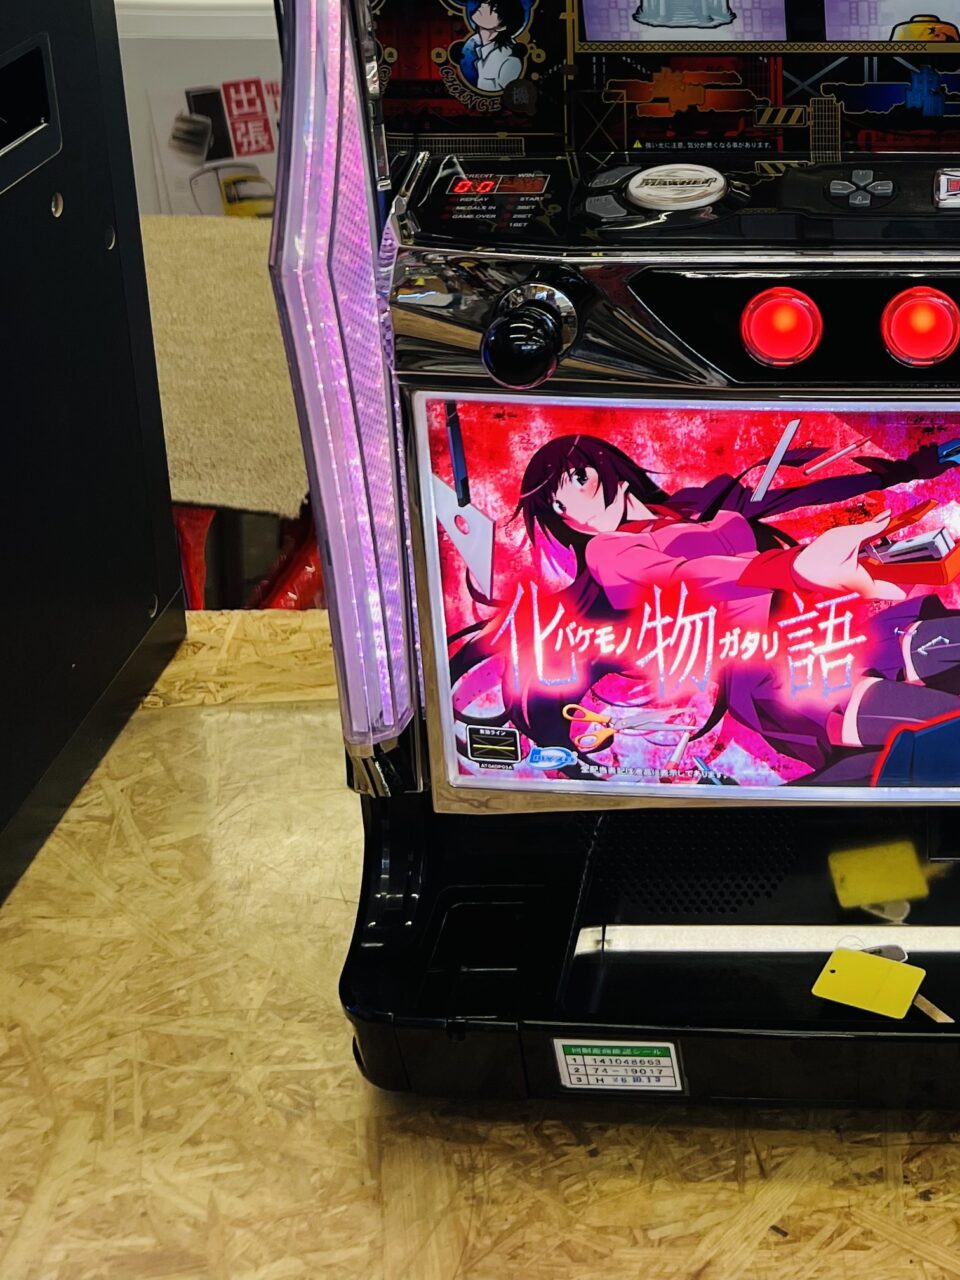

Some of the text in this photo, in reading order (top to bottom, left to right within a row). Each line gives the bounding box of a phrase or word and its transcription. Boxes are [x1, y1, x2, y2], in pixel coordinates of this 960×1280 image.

[440, 66, 501, 111] CHANCE
[490, 580, 868, 700] 化 バケモノ 物 ガタリ 語
